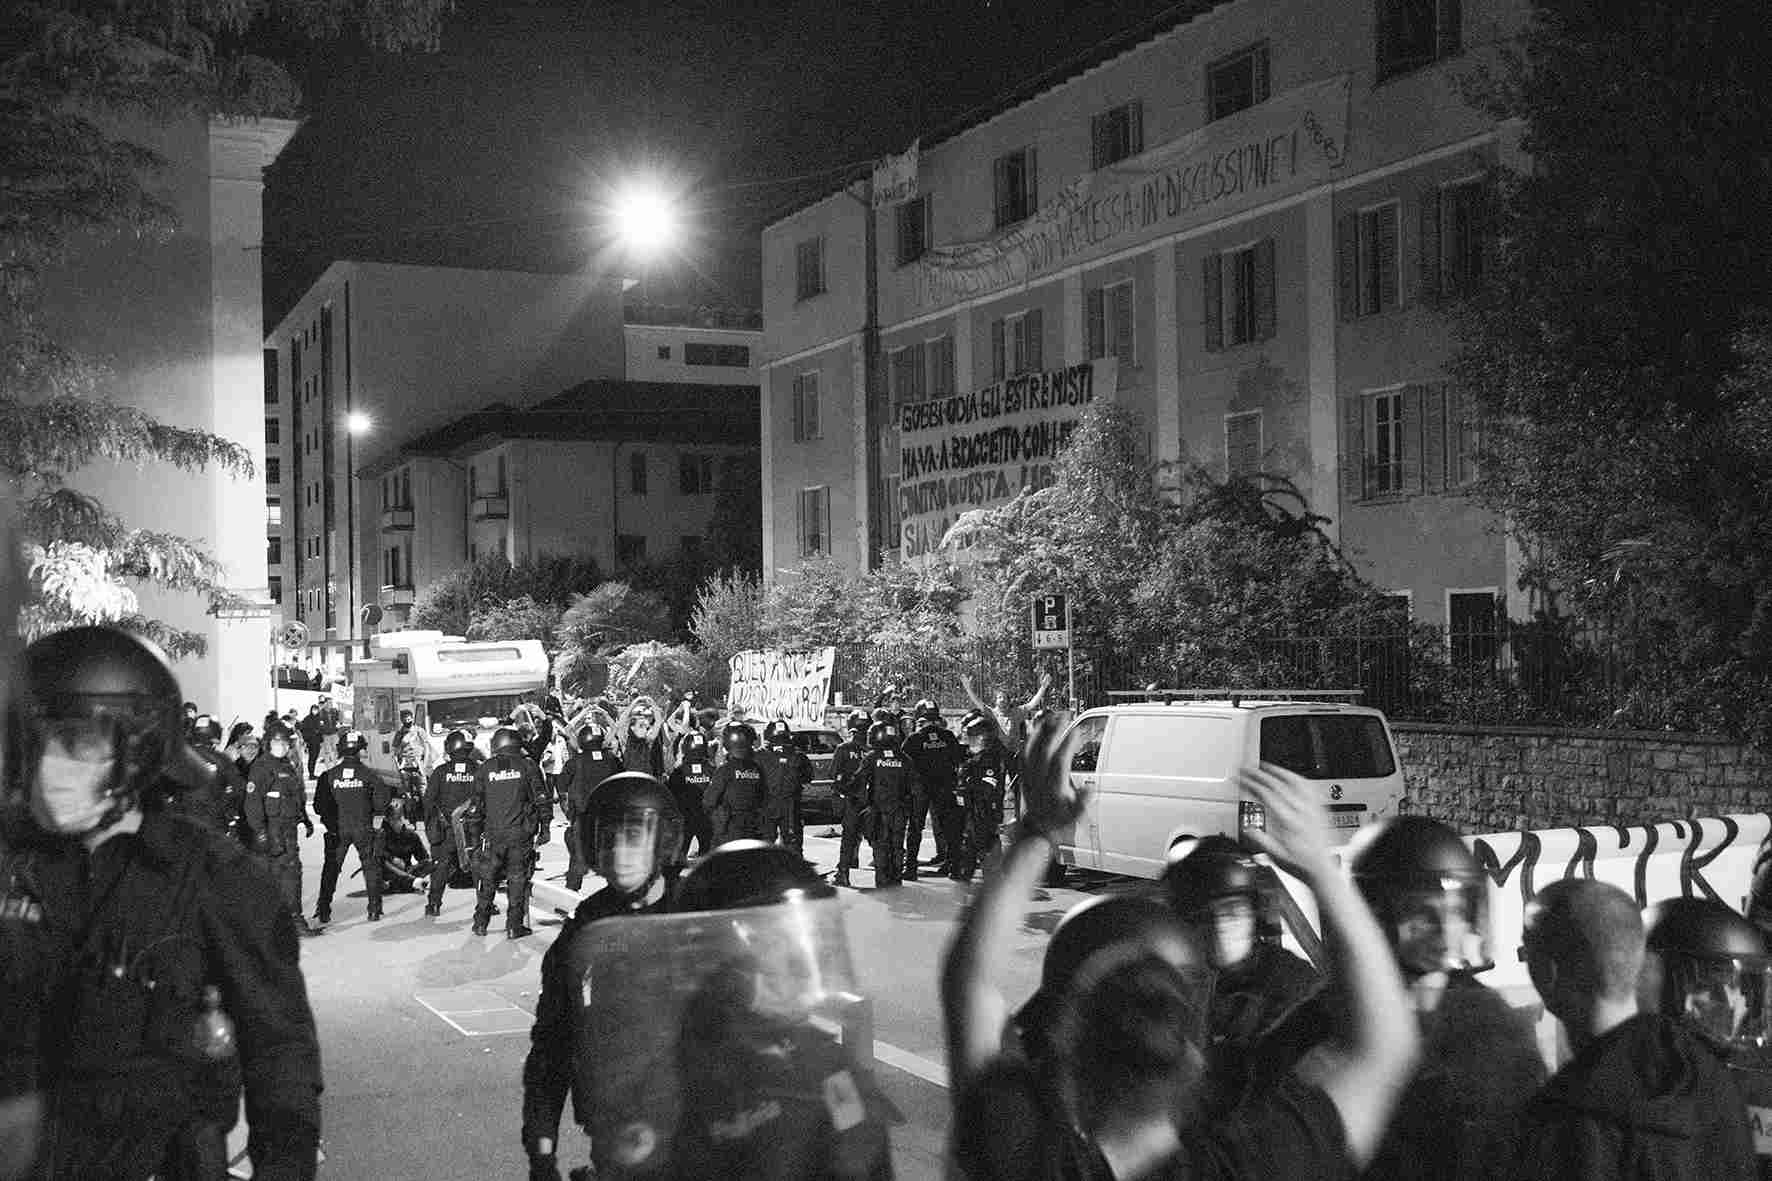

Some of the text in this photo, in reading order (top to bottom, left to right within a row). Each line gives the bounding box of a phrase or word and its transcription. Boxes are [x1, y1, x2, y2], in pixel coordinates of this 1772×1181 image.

[1004, 363, 1094, 414] ESTREMISTI
[1044, 596, 1056, 614] P
[876, 759, 903, 768] Polizia
[446, 772, 475, 783] Polizia
[488, 768, 521, 782] Polizia
[685, 775, 710, 785] Polizia
[735, 769, 761, 780] Polizia
[333, 778, 364, 789] Polizia
